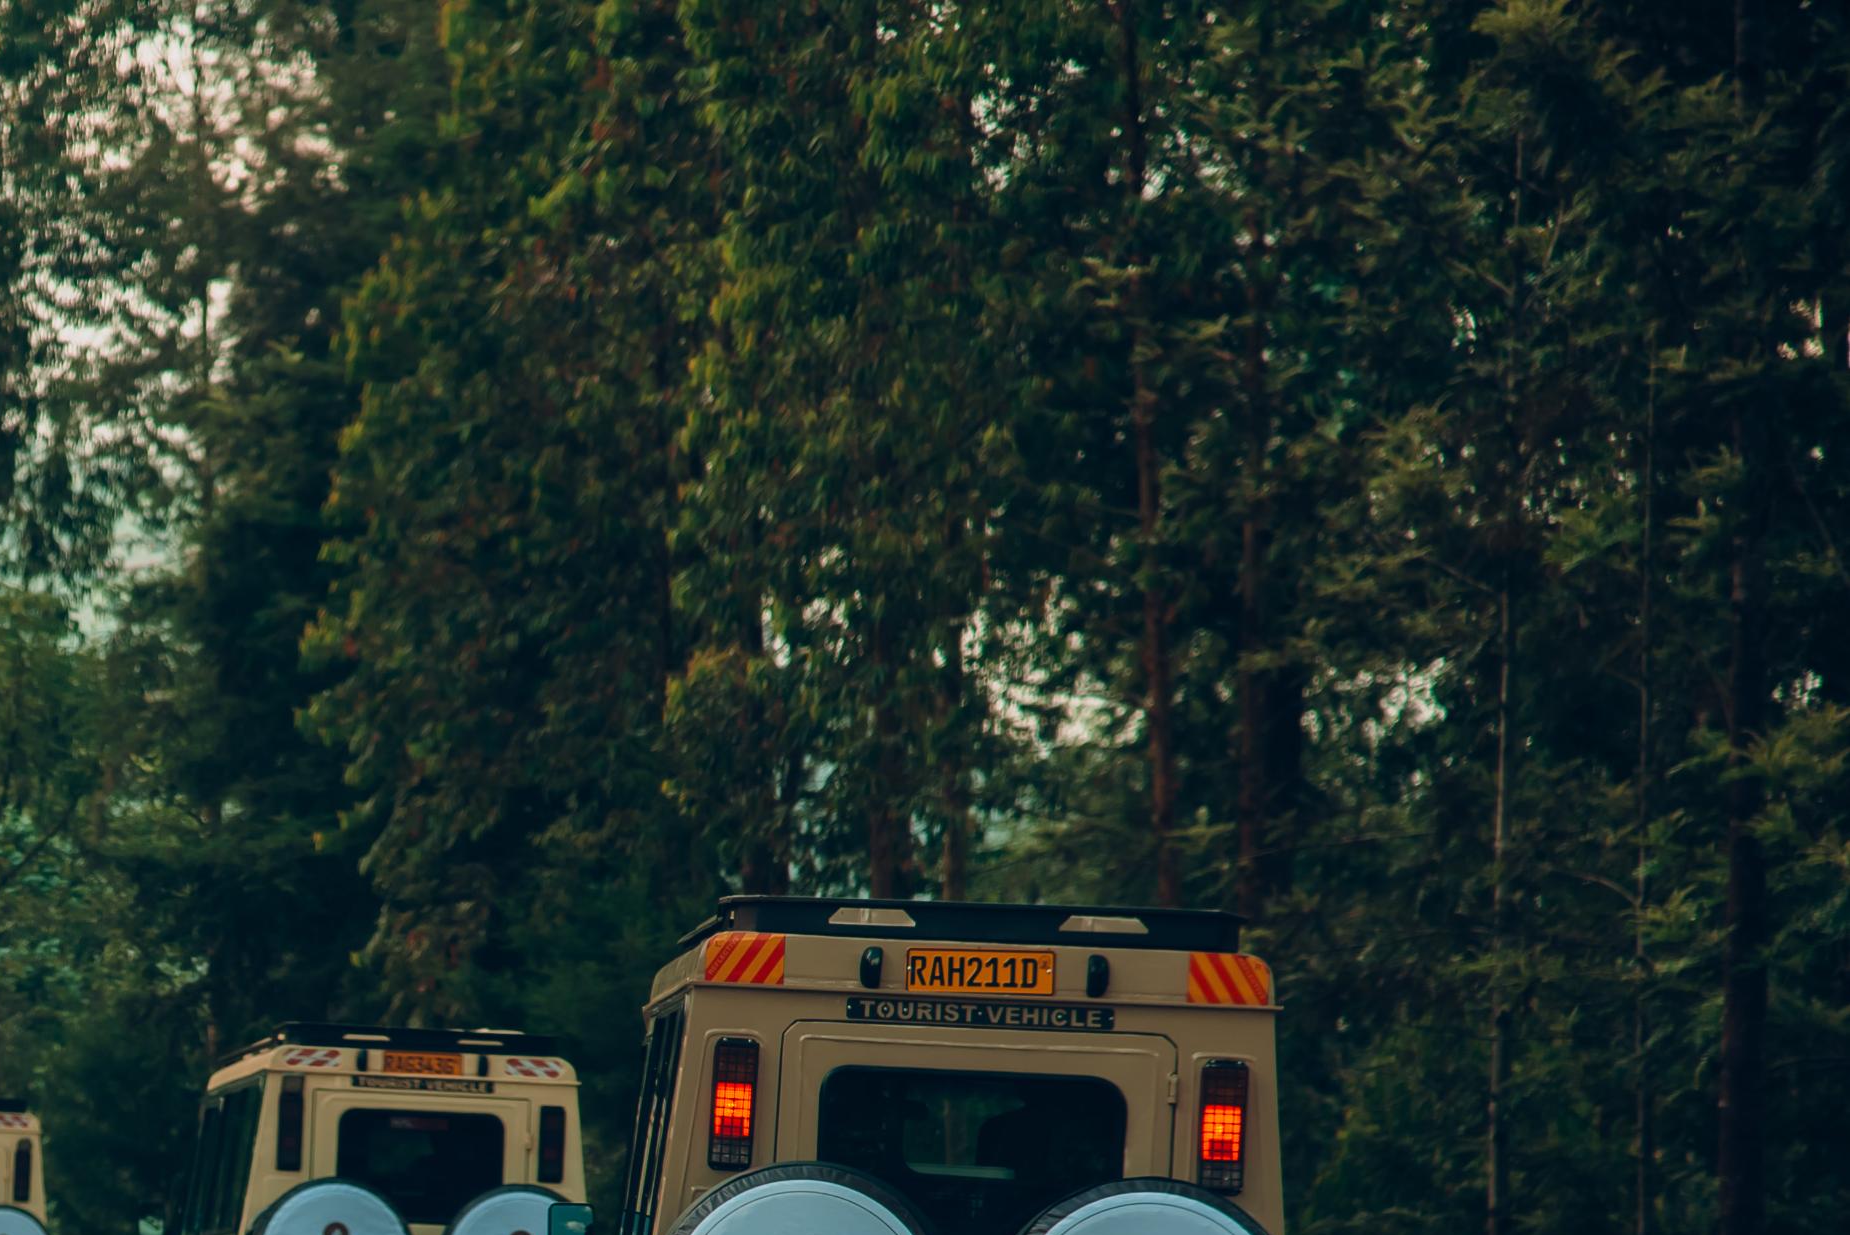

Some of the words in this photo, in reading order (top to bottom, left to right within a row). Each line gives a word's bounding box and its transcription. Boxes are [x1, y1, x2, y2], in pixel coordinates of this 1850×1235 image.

[909, 955, 1039, 988] RAH211D
[860, 1000, 977, 1023] TOURIST
[985, 1006, 1102, 1028] VEHICLE
